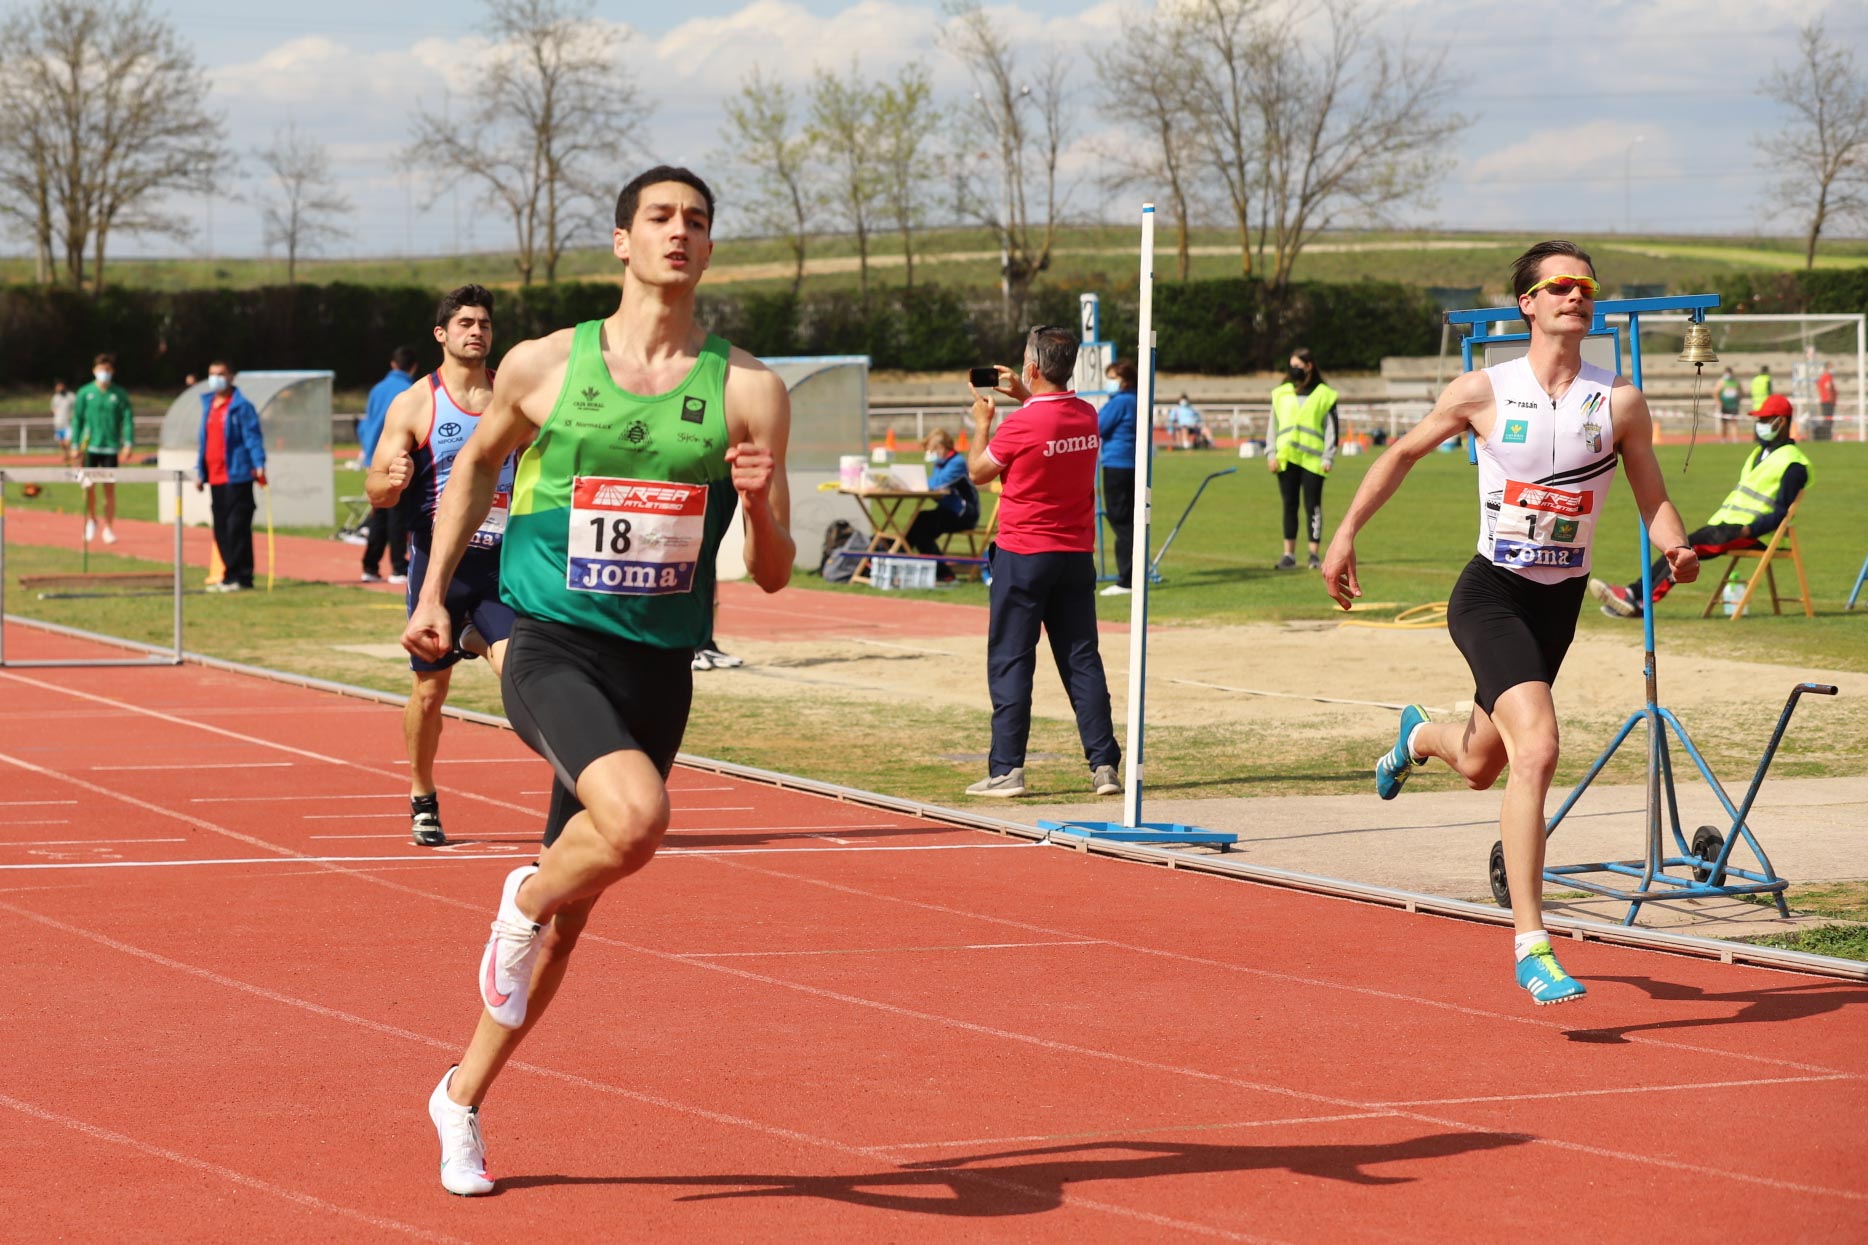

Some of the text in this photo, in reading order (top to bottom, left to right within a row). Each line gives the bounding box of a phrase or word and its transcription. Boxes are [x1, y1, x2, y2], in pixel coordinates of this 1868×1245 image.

[1084, 300, 1094, 330] 2
[1042, 434, 1098, 457] Joma
[623, 500, 684, 511] ATLETISMO
[627, 486, 690, 503] RFEA
[590, 516, 632, 554] 18
[1525, 514, 1537, 540] 1
